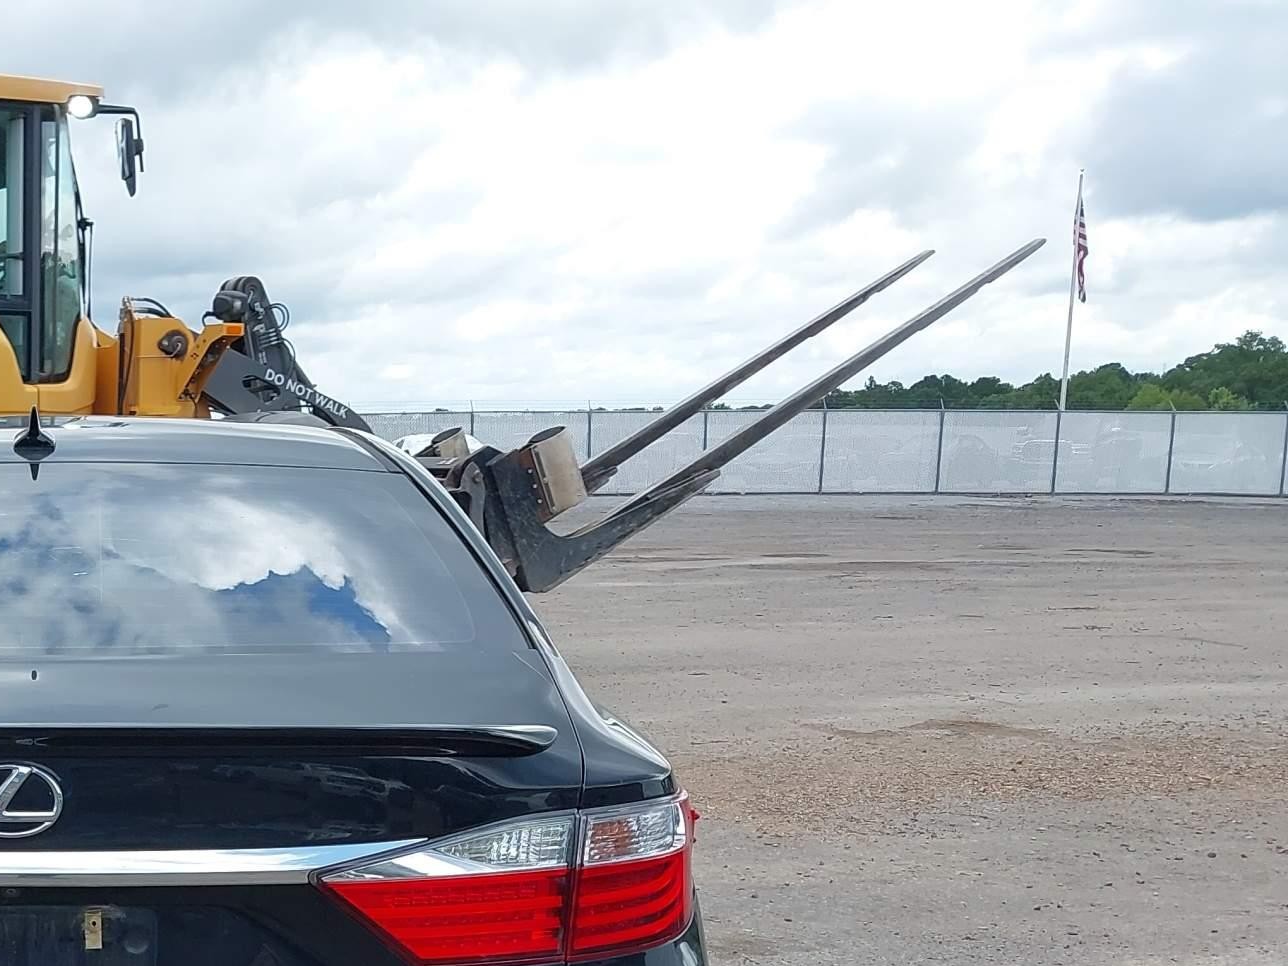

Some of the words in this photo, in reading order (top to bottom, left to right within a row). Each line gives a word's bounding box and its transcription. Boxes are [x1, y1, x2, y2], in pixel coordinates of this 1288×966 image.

[265, 368, 285, 386] DO
[286, 379, 314, 400] NOT
[315, 393, 348, 418] WALK
